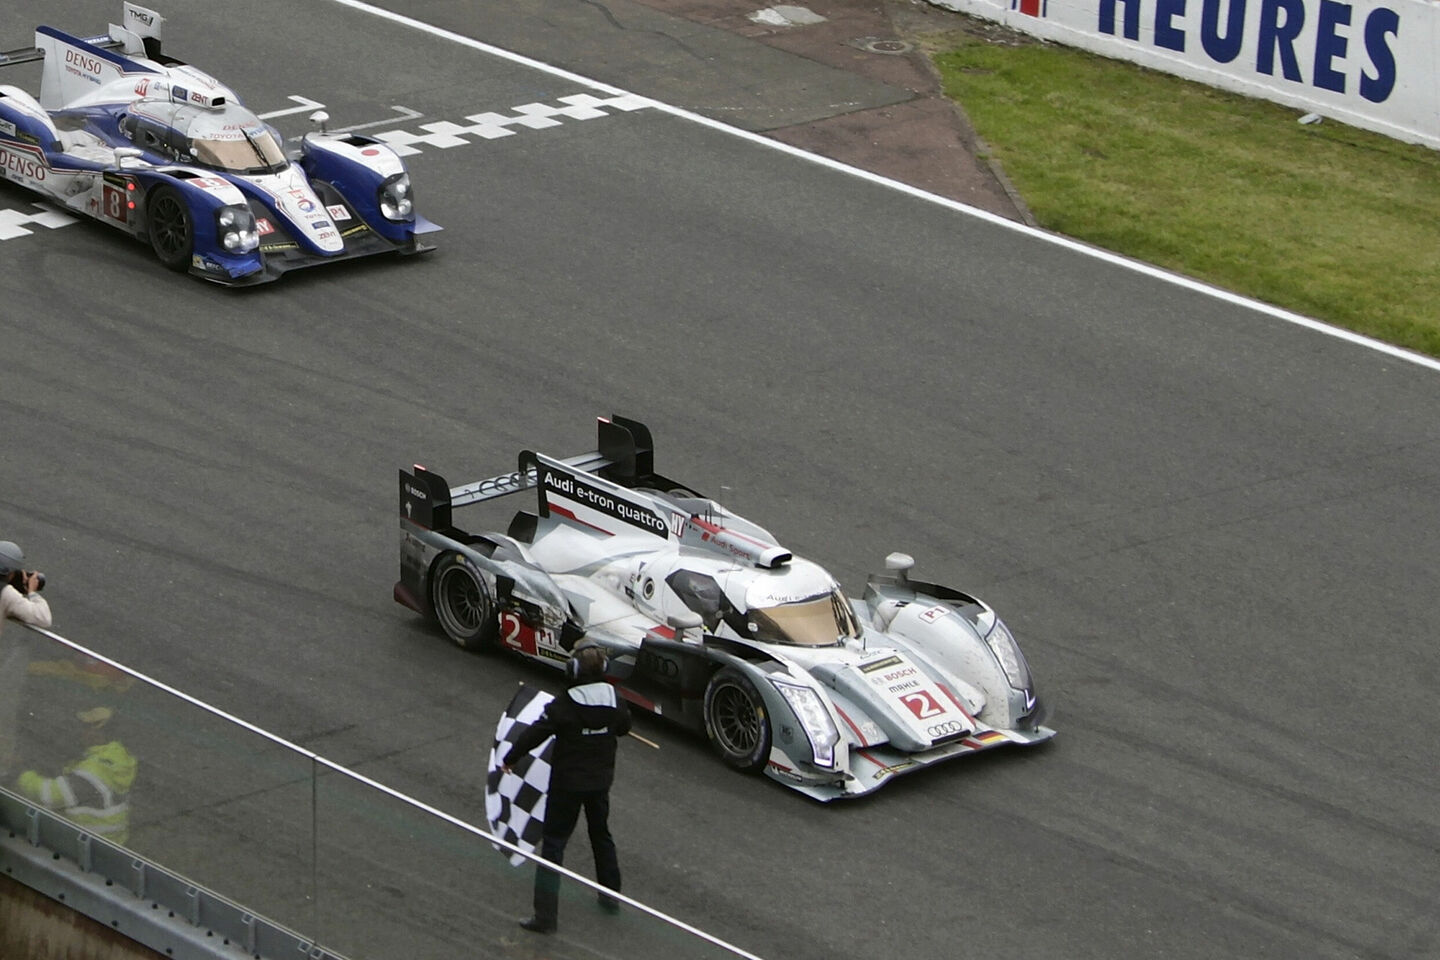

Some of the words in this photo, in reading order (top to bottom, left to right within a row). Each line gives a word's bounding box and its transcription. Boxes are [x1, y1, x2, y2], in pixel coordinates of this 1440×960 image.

[65, 49, 102, 75] DENSO
[191, 91, 209, 105] ZENT
[110, 191, 121, 218] 8
[331, 207, 347, 219] P1
[410, 486, 427, 500] BOSCH
[544, 471, 574, 494] Audi
[576, 482, 614, 511] e-tron
[617, 499, 665, 532] quattro
[671, 512, 685, 537] HY
[729, 543, 752, 560] Sport
[924, 607, 946, 619] P1
[505, 614, 522, 648] 2
[539, 628, 554, 646] P1
[885, 667, 917, 682] BOSCH
[888, 680, 921, 694] MAHLE
[905, 693, 941, 718] 2
